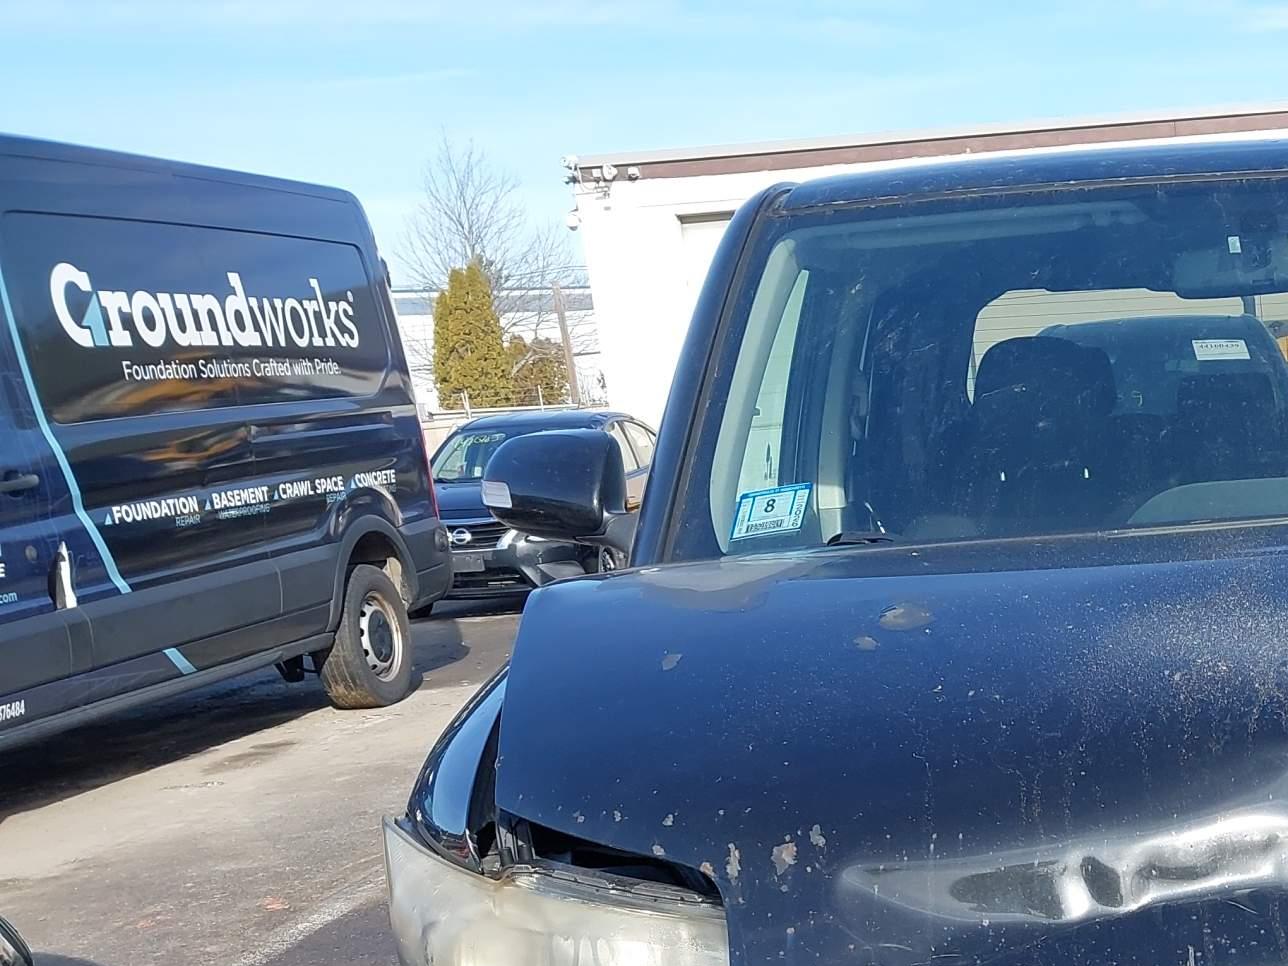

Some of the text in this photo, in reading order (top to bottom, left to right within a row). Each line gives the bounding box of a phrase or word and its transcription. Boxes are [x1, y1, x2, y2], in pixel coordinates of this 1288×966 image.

[50, 262, 359, 348] Groundworks
[122, 358, 342, 380] Foundation Solutions Crafted with Pride.
[111, 495, 199, 524] FOUNDATION
[211, 486, 269, 510] BASEMENT
[278, 480, 315, 499] CRAWL
[314, 476, 345, 494] SPACE
[354, 469, 396, 488] CONCRETE
[764, 499, 776, 513] 8
[175, 515, 201, 528] REPAIR
